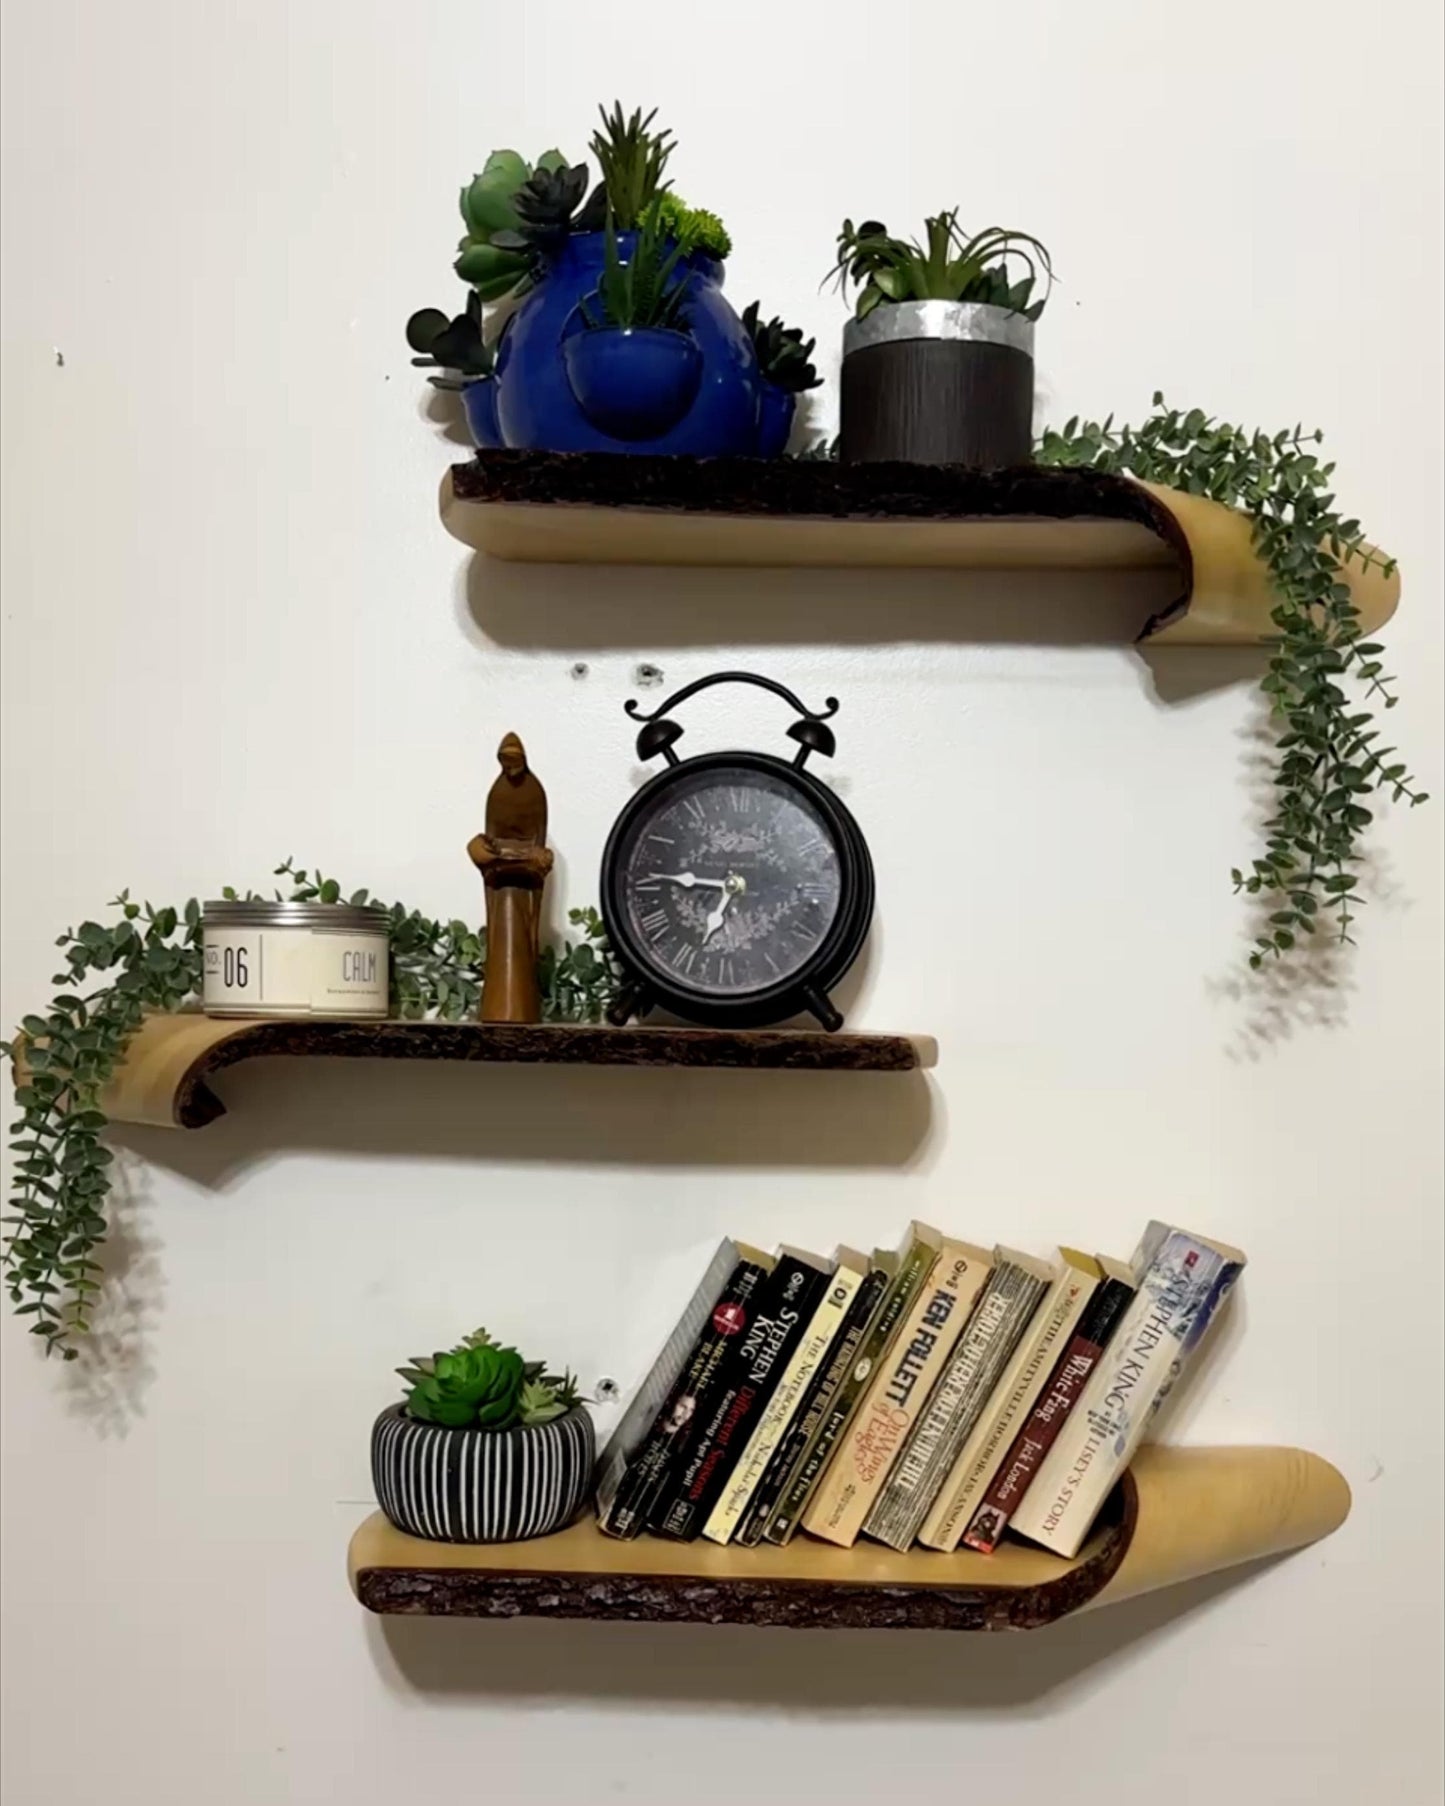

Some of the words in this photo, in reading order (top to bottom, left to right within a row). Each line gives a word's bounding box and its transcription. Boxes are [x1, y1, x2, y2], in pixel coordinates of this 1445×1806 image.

[224, 947, 248, 987] 06
[343, 951, 376, 983] CALM
[921, 1288, 957, 1330] KEN
[961, 1290, 1013, 1362] OCTOBER
[1131, 1269, 1191, 1361] STEPHEN
[739, 1314, 776, 1363] KING
[748, 1306, 800, 1385] STEPHEN
[806, 1333, 829, 1360] THE
[1043, 1319, 1063, 1343] THE
[884, 1327, 937, 1408] FOLLETT
[946, 1356, 977, 1390] RED
[1002, 1343, 1049, 1422] AMITYVILLE
[1056, 1352, 1093, 1394] White
[1103, 1358, 1144, 1412] KING
[704, 1388, 736, 1438] featuring
[771, 1360, 813, 1426] NOTEBOOK
[870, 1400, 891, 1418] of
[1033, 1389, 1070, 1425] Fang
[716, 1384, 757, 1447] Different
[823, 1411, 845, 1440] lord
[883, 1407, 911, 1438] On
[696, 1437, 712, 1458] Apt
[815, 1441, 826, 1456] of
[850, 1415, 888, 1466] Eagles
[855, 1430, 897, 1485] Wings
[974, 1420, 1008, 1474] HORROR
[1016, 1437, 1043, 1463] Jack
[682, 1457, 703, 1487] Pupil
[688, 1447, 726, 1502] Seasons
[804, 1458, 819, 1476] the
[894, 1456, 926, 1492] THE
[996, 1460, 1030, 1502] London
[1065, 1436, 1101, 1488] LISEY'S
[790, 1476, 811, 1502] flies
[1040, 1485, 1074, 1537] STORY
